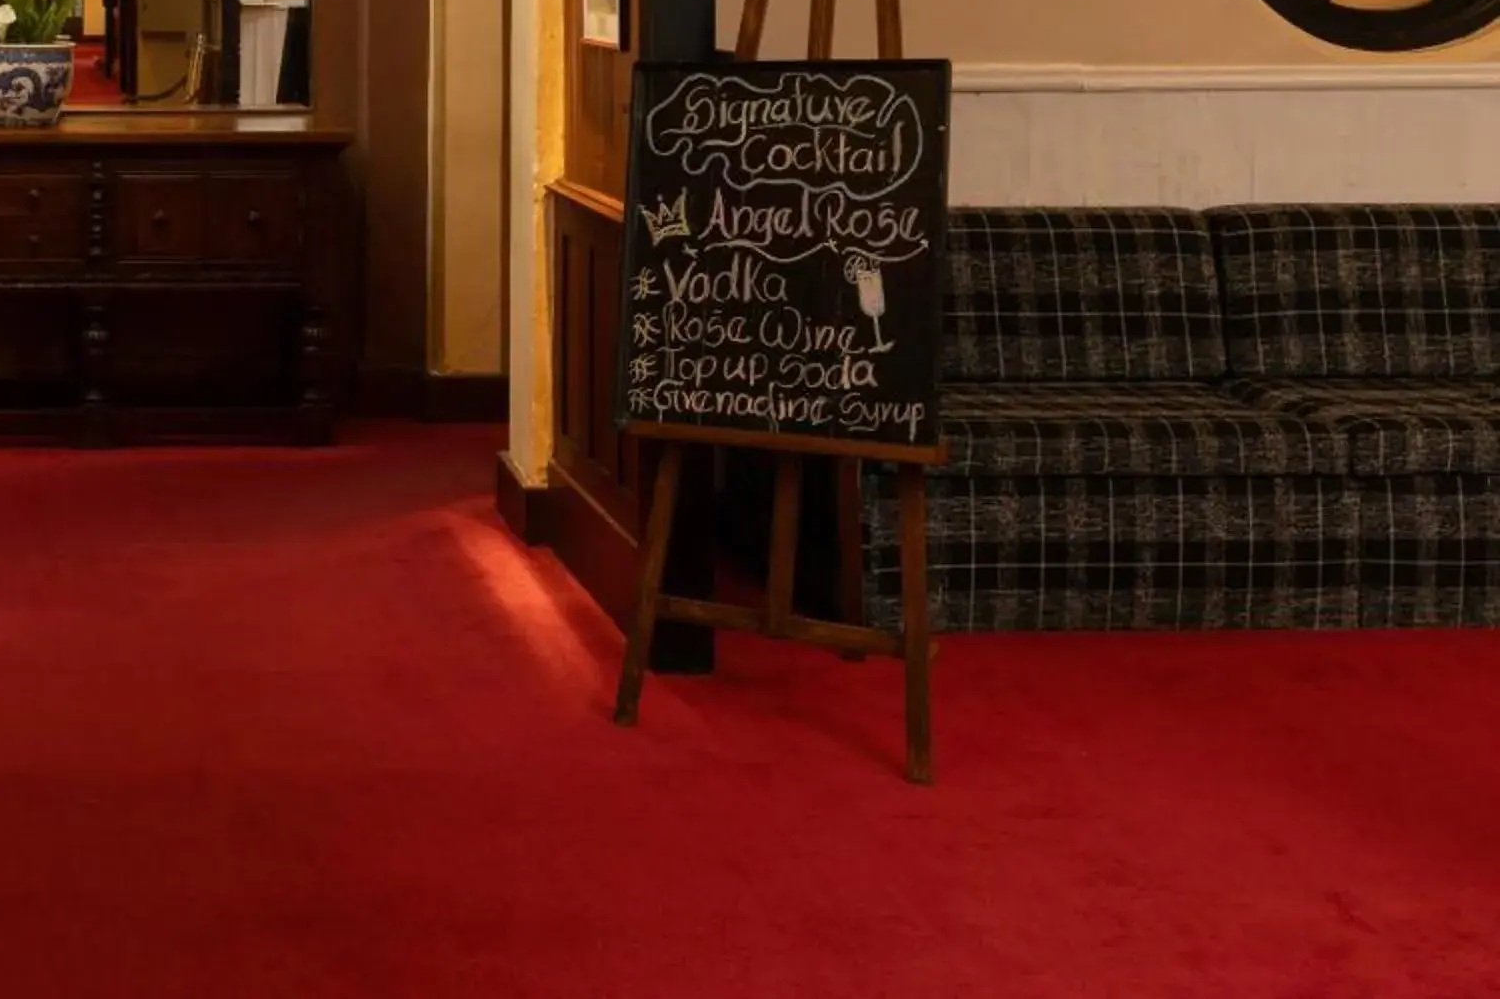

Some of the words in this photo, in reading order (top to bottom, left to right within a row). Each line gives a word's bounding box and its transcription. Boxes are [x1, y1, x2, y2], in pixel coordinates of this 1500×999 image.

[660, 78, 875, 148] Signature
[741, 122, 904, 182] Cocktail
[698, 188, 812, 246] Angel
[664, 253, 788, 303] Vodka
[760, 306, 865, 354] Wine
[658, 347, 717, 387] Top
[724, 353, 768, 387] up
[780, 354, 878, 390] Soda
[653, 378, 833, 428] Grenadine
[839, 392, 925, 442] Syrup
